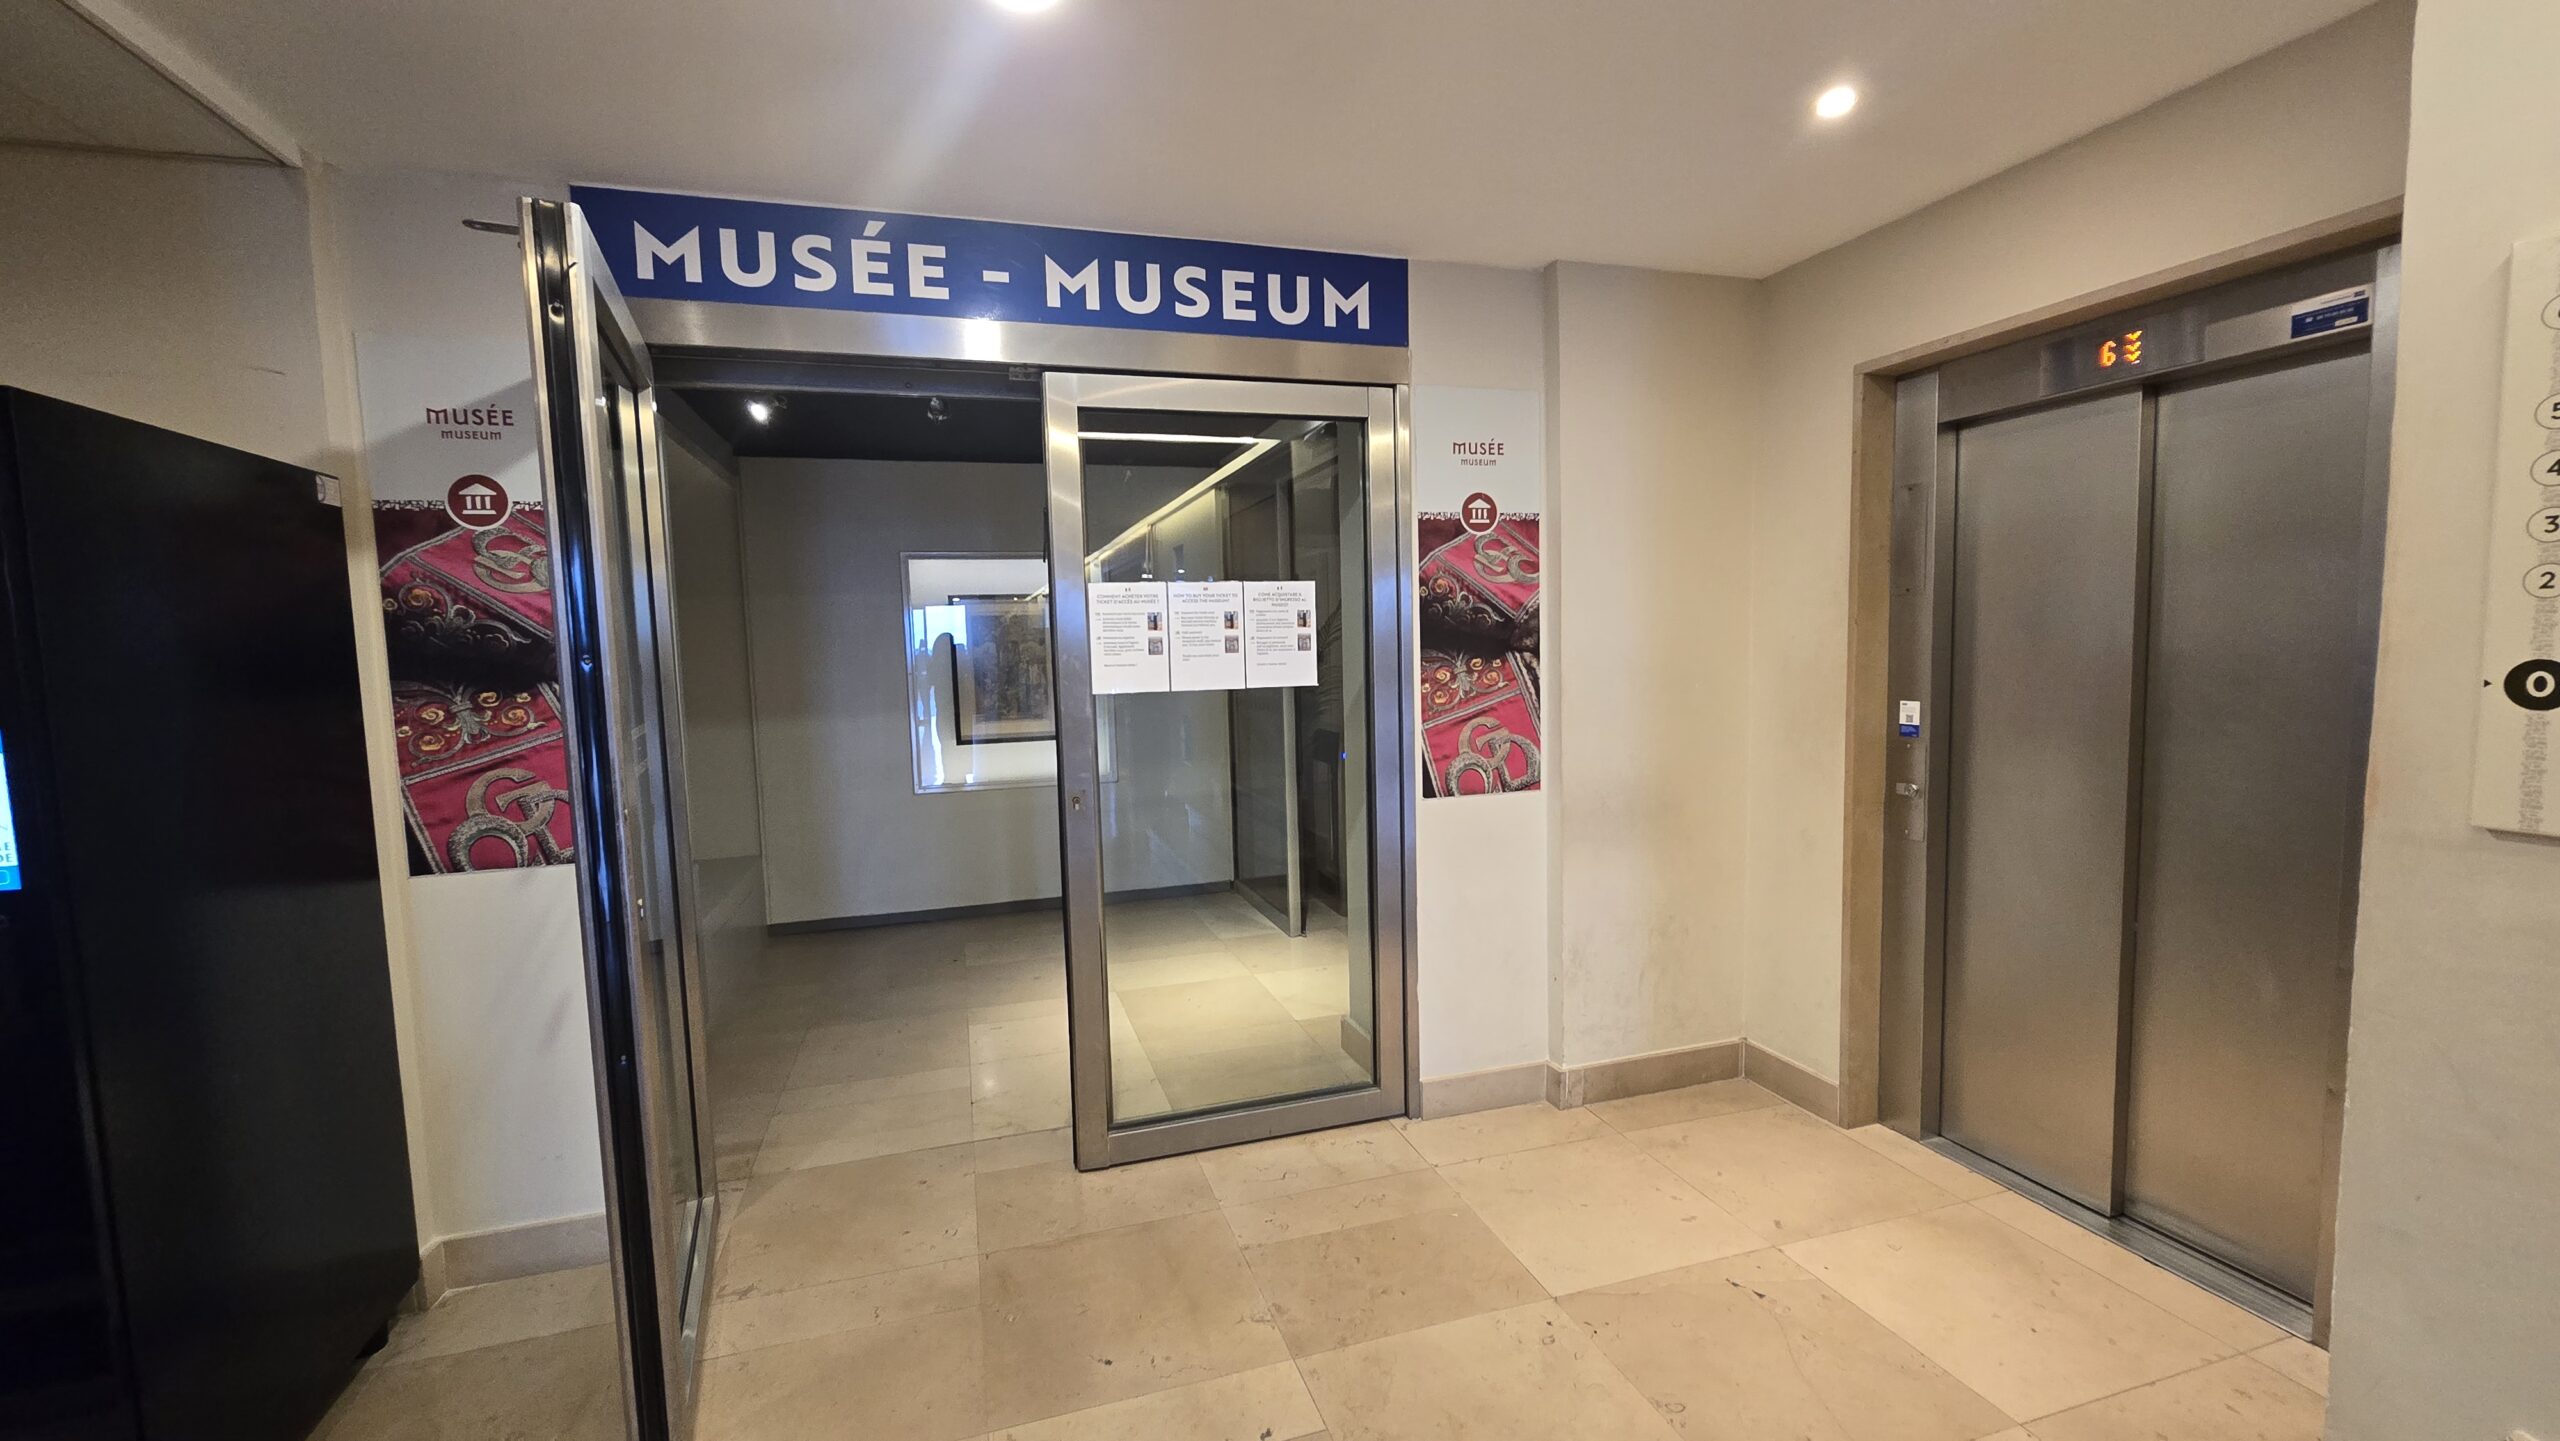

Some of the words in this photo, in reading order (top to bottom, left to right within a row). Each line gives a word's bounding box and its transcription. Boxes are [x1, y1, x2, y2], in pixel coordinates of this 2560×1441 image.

[634, 220, 950, 300] MUSÉE
[982, 269, 1010, 284] -
[1044, 254, 1370, 330] MUSEUM
[2099, 340, 2117, 367] 6
[426, 404, 514, 426] MUSÉE
[1453, 438, 1505, 456] MUSÉE
[2544, 514, 2560, 534] 3
[2539, 571, 2556, 590] 2
